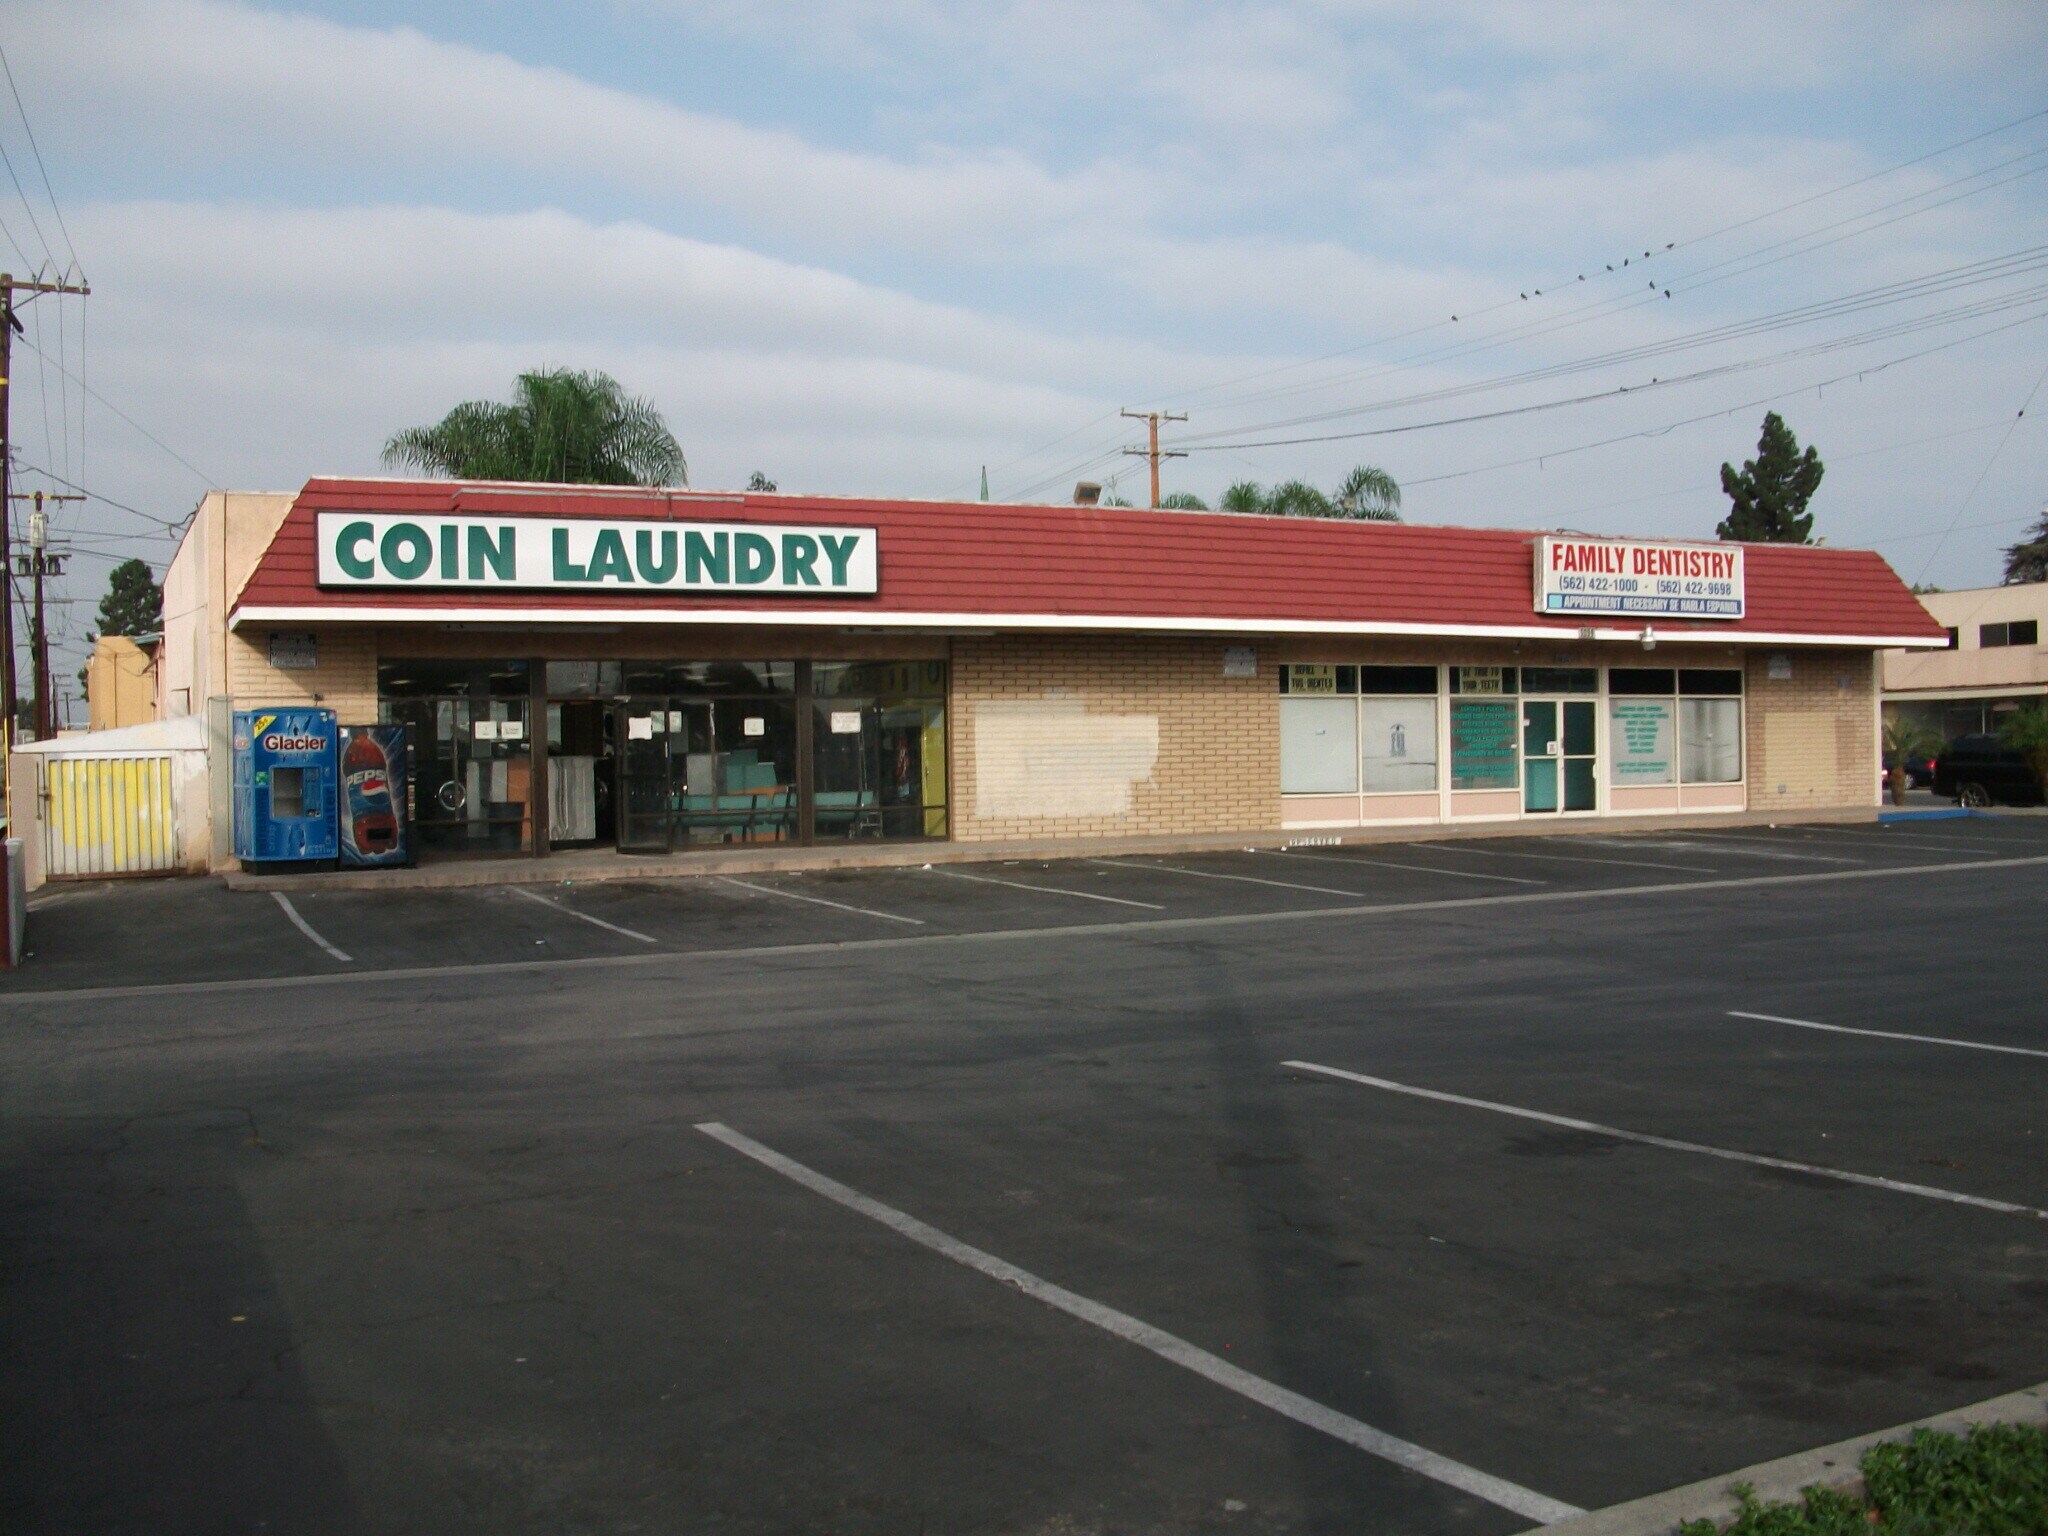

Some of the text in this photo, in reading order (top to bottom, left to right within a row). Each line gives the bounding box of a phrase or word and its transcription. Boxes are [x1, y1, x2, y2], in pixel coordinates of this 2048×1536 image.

[335, 521, 861, 587] COIN LAUNDRY
[1552, 543, 1735, 579] FAMILY DENTISTRY
[1559, 575, 1586, 592] (562)
[1588, 577, 1638, 593] 422-1000
[1656, 578, 1681, 595] (562)
[1685, 581, 1732, 596] 422-9698
[1564, 595, 1621, 611] APPOINTMENT
[1623, 598, 1668, 612] NECESSARY
[1669, 600, 1679, 613] SE
[1680, 600, 1705, 613] HABLA
[264, 735, 327, 751] Glacier
